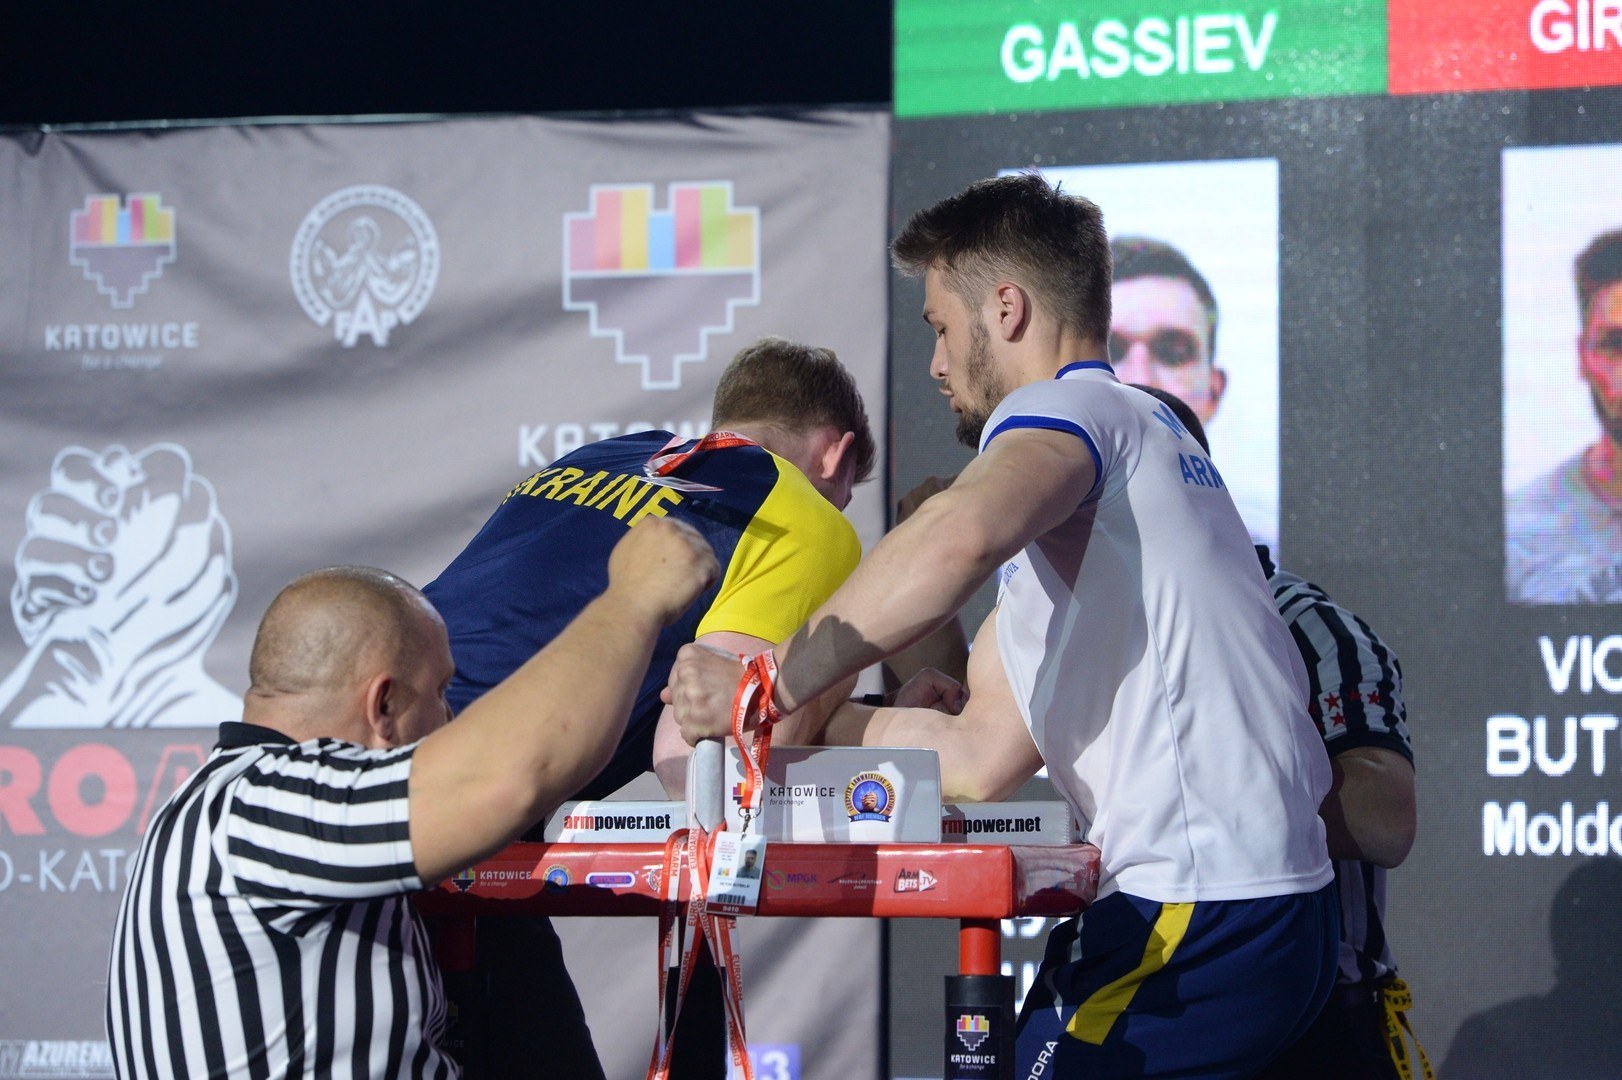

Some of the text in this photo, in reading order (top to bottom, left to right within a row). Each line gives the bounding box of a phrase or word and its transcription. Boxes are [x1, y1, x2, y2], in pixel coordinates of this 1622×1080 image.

[1530, 0, 1622, 53] GIR
[1002, 11, 1277, 82] GASSIEV
[44, 321, 200, 351] KATOWICE
[518, 423, 713, 468] KAT
[1486, 714, 1618, 776] BUT
[769, 798, 778, 806] for
[783, 798, 804, 806] change
[770, 787, 835, 797] KATOWICE
[564, 814, 671, 831] armpower.net
[480, 871, 532, 880] KATOWICE
[950, 1054, 995, 1064] KATOWICE
